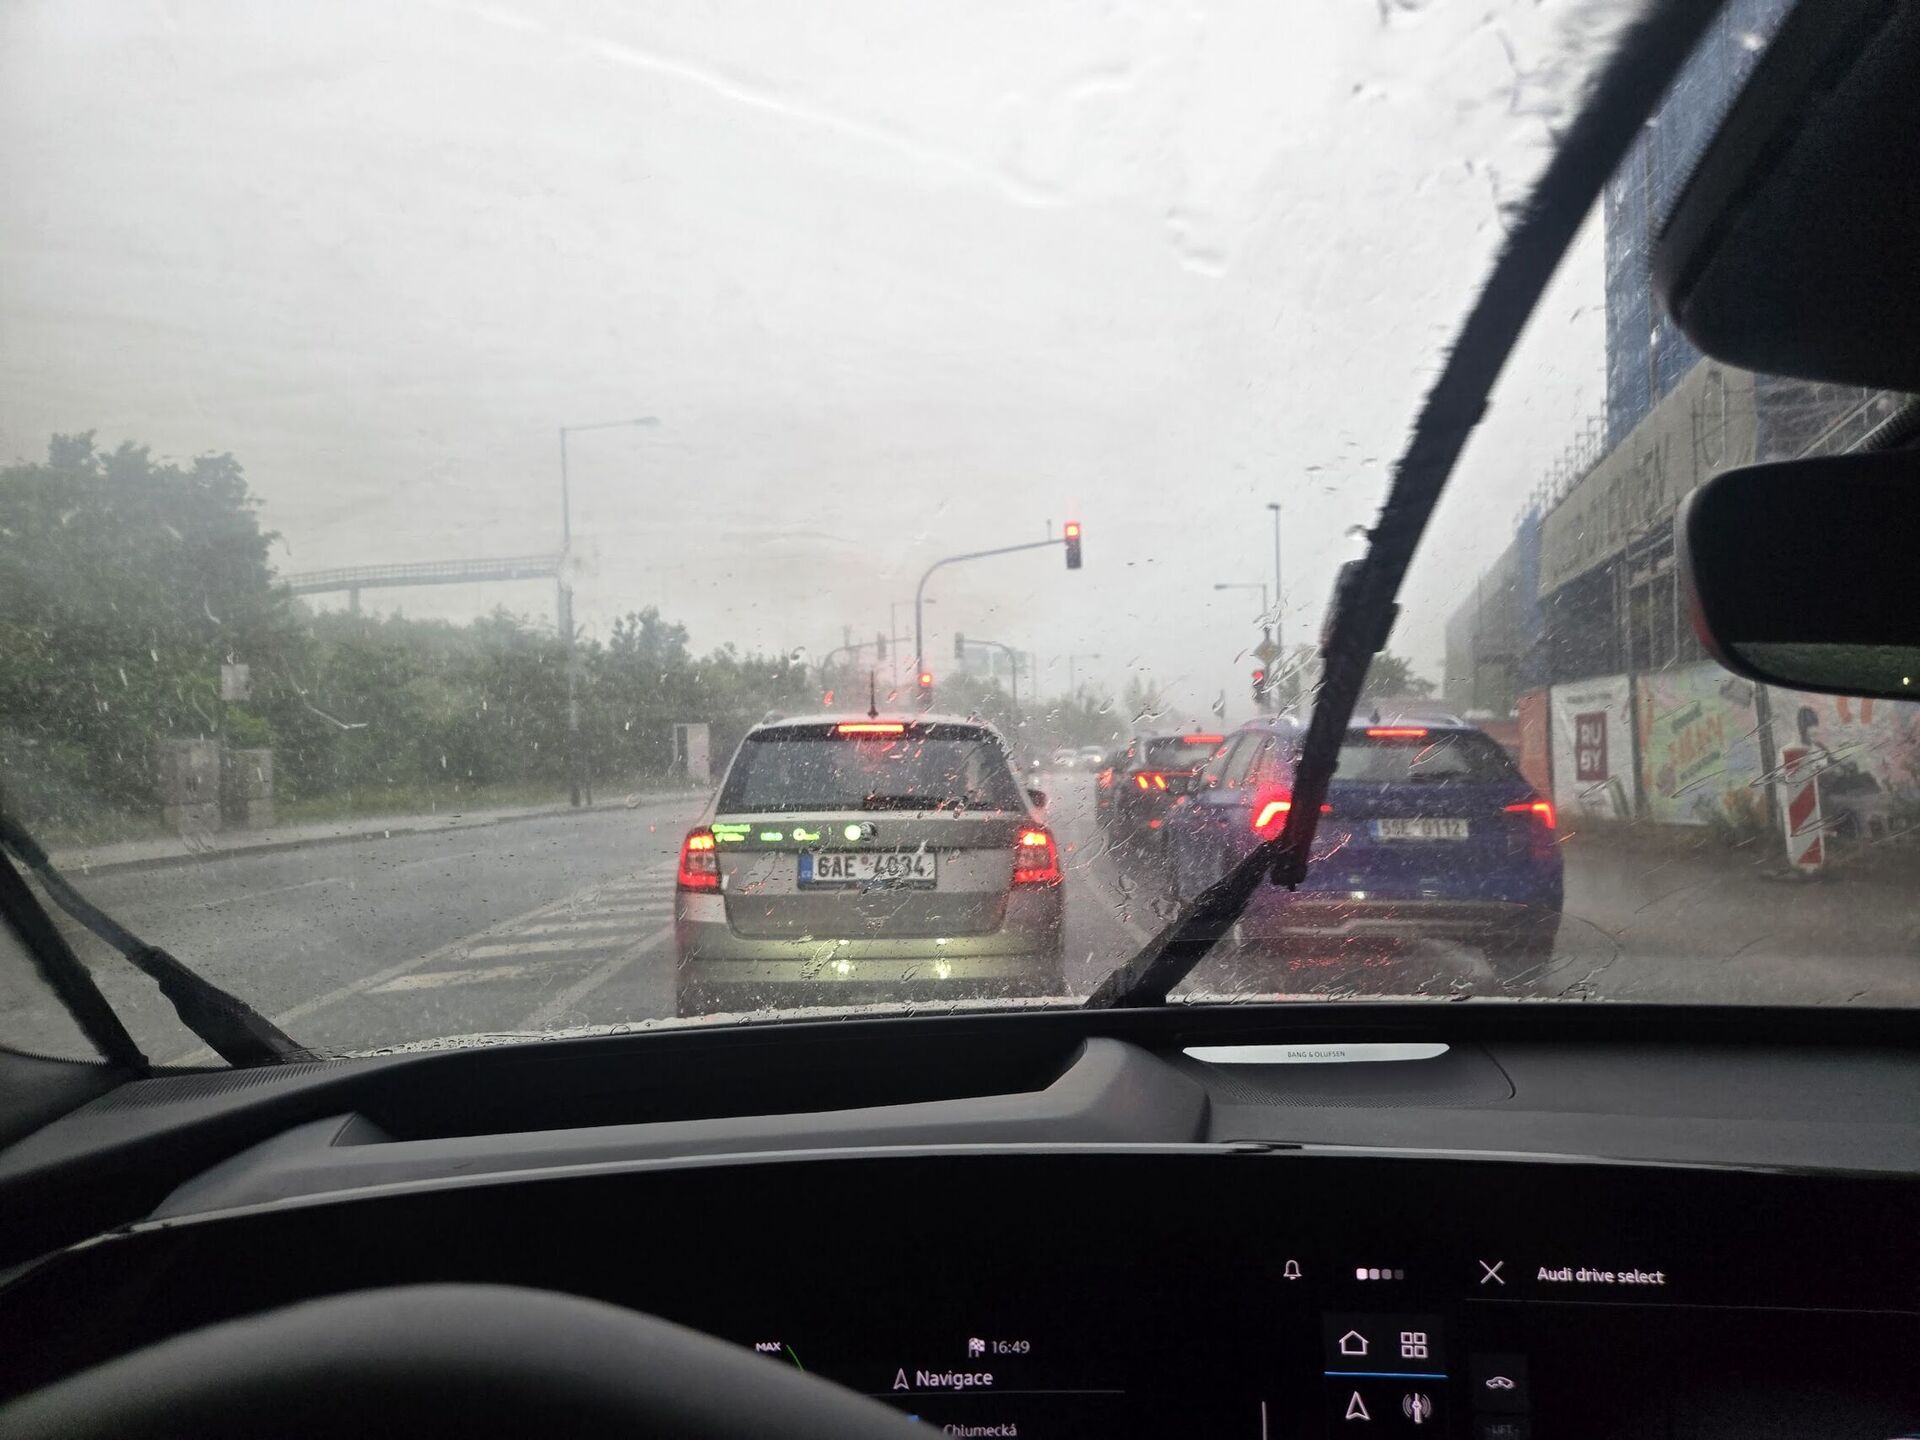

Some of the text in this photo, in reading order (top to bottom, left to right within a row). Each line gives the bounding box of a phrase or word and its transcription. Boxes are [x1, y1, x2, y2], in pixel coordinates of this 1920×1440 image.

[1580, 721, 1602, 747] RU
[818, 855, 925, 877] 6AE 4034
[1537, 1266, 1665, 1284] Audi drive select
[755, 1341, 781, 1352] MAX
[992, 1340, 1031, 1354] 16:49
[916, 1370, 994, 1390] Navigace
[943, 1423, 1018, 1438] Chlumecká
